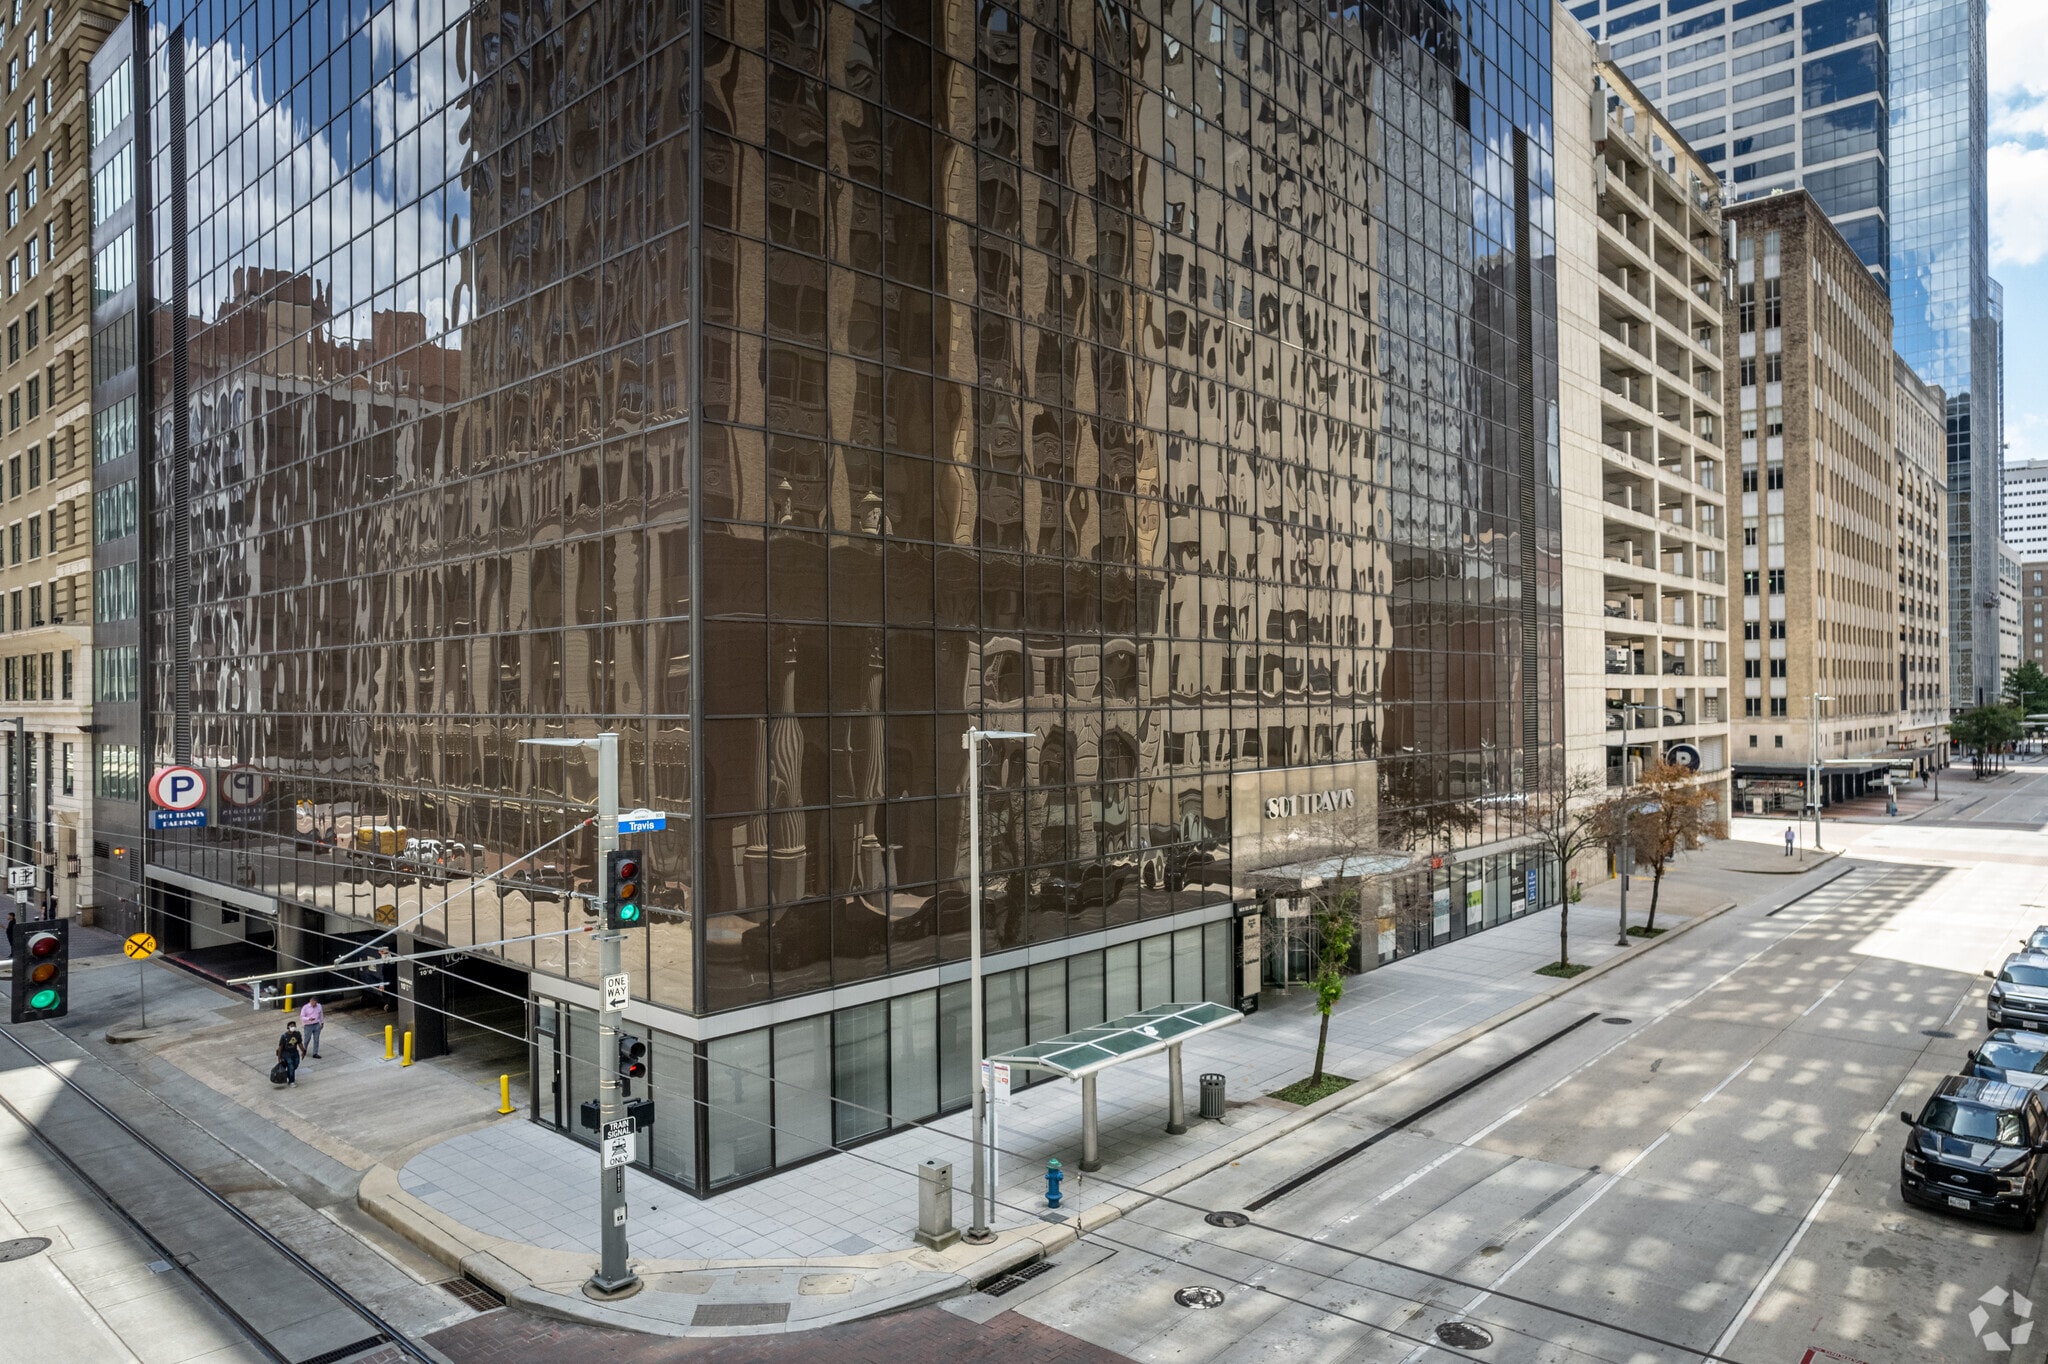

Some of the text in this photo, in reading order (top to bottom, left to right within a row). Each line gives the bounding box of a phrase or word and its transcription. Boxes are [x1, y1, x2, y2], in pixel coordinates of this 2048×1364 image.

[171, 776, 194, 802] P
[1265, 788, 1354, 819] 801 TRAVIS
[176, 811, 204, 819] TRAVIS
[162, 819, 199, 827] PARKING
[629, 821, 655, 831] Travis
[147, 941, 153, 949] R
[608, 976, 625, 987] ONE
[607, 986, 626, 997] WAY
[609, 1120, 629, 1131] TRAIN
[607, 1127, 631, 1139] SIGNAL
[610, 1155, 629, 1166] ONLY
